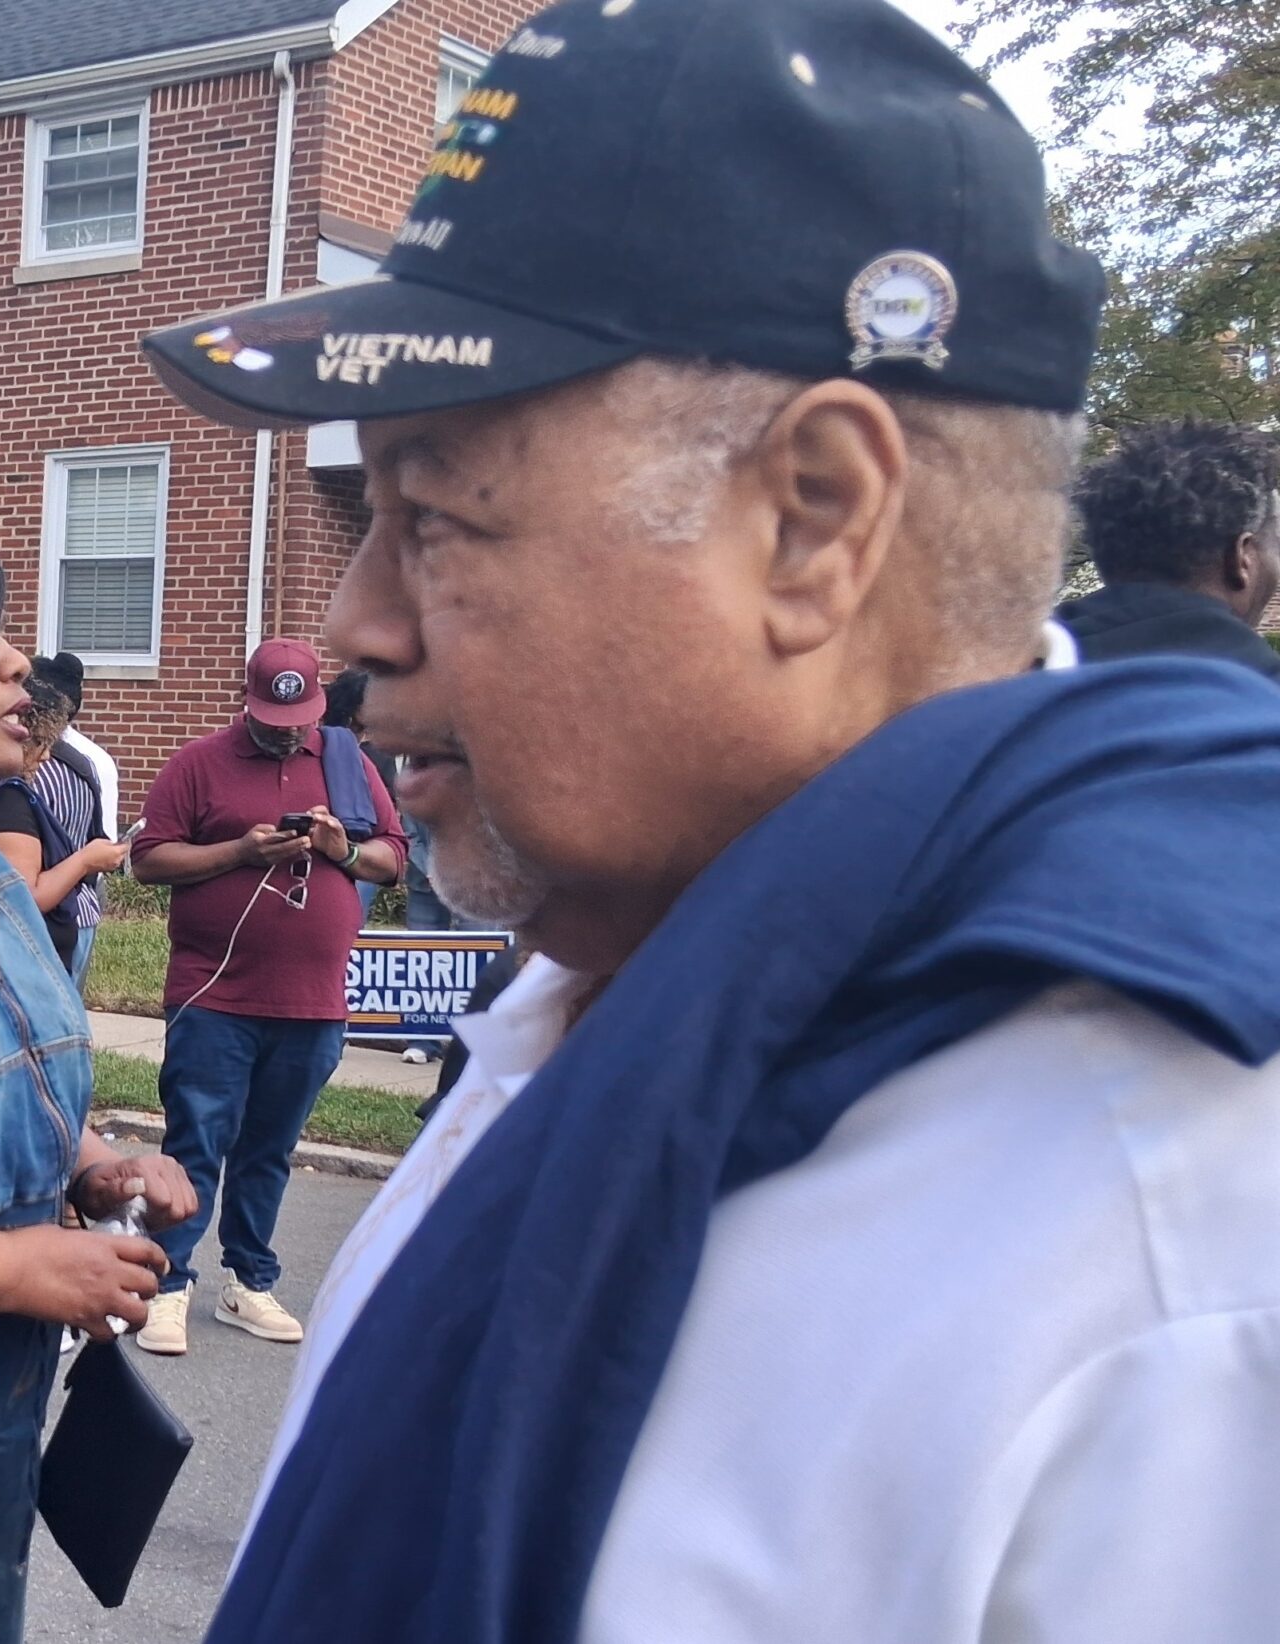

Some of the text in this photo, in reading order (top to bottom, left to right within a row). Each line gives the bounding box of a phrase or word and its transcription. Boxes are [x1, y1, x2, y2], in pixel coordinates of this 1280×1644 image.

[323, 333, 493, 367] VIETNAM
[316, 354, 389, 385] VET
[404, 1014, 427, 1024] FOR
